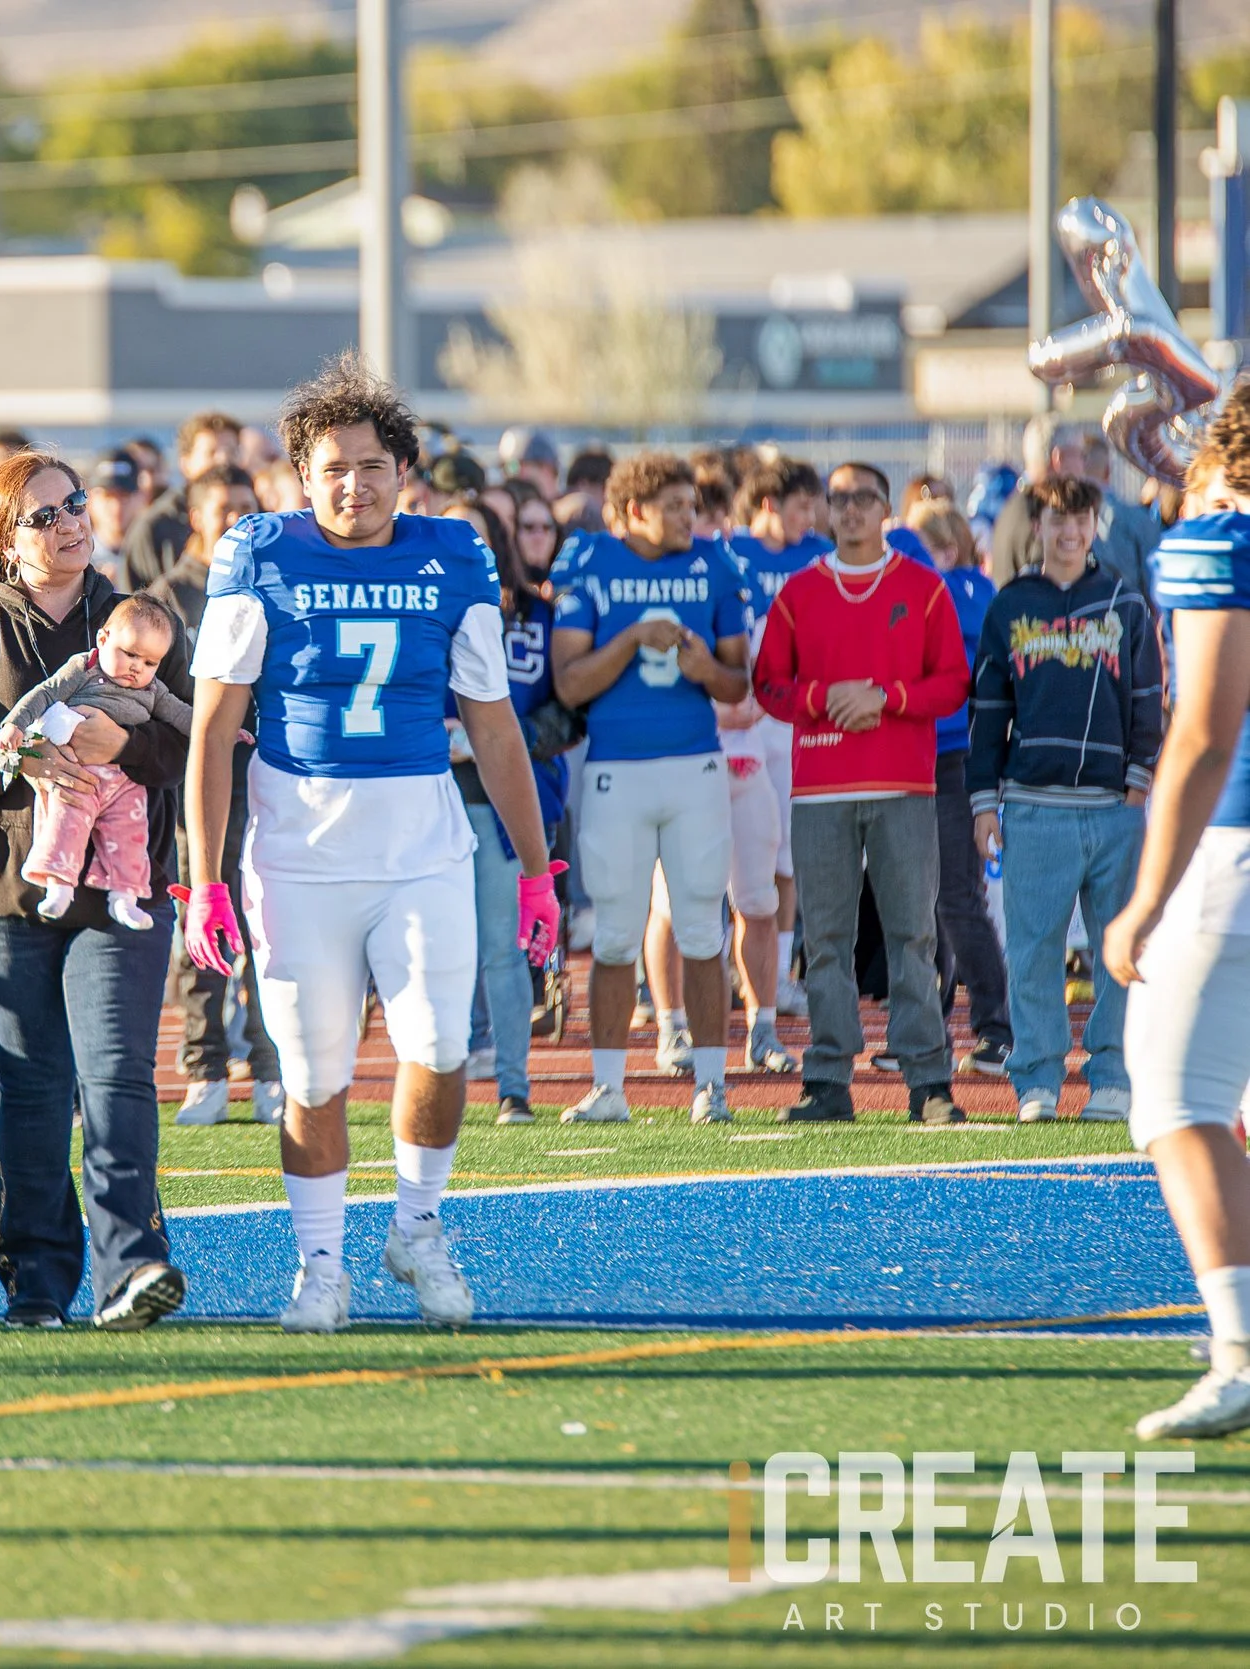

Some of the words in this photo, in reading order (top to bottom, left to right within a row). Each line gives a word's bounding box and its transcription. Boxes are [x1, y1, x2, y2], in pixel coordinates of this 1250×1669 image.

[294, 583, 440, 611] SENATORS
[609, 578, 709, 602] SENATORS
[336, 618, 400, 738] 7
[596, 773, 612, 793] C
